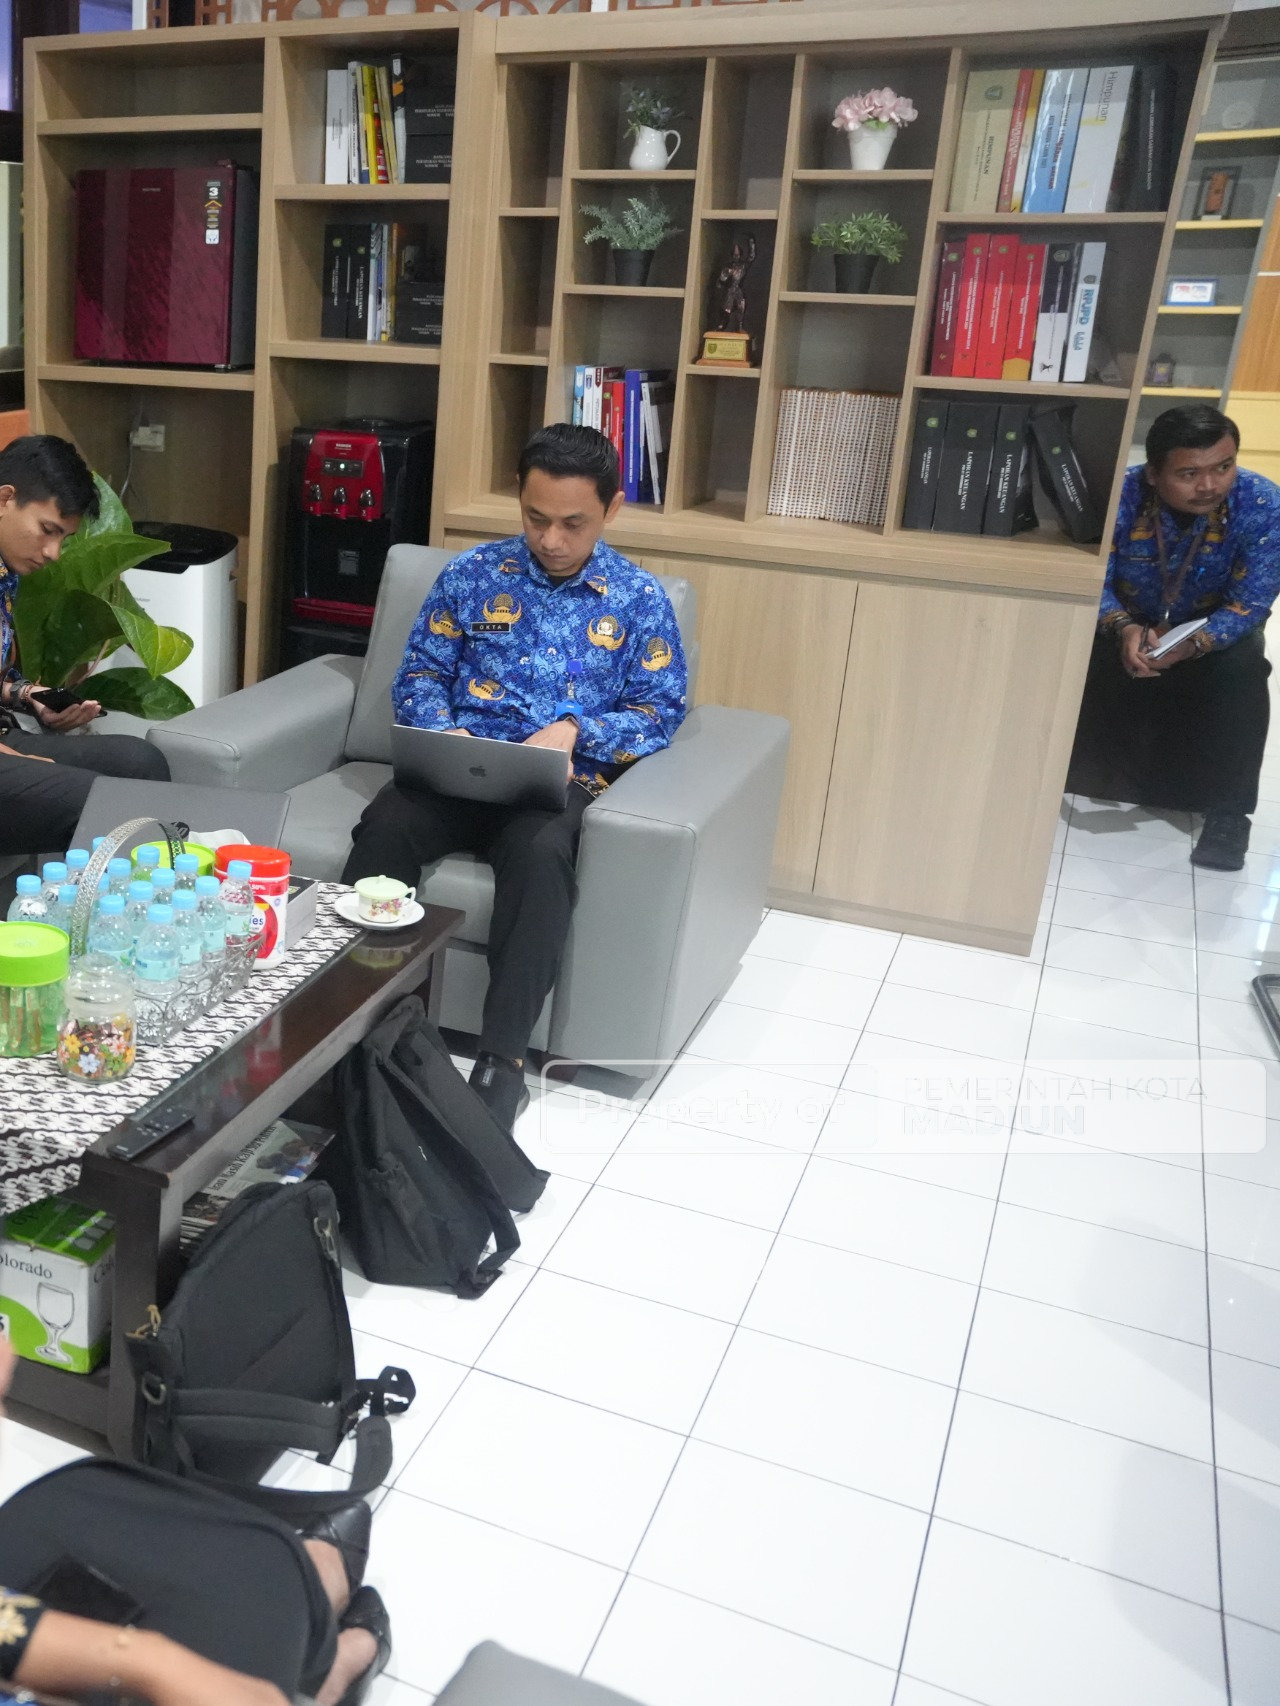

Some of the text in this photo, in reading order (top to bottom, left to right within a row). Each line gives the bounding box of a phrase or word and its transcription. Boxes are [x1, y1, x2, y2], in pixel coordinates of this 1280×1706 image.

[208, 186, 219, 197] 3
[1079, 288, 1095, 325] RPJPD
[964, 451, 974, 478] LAPORAN
[1003, 454, 1013, 481] LAPORAN
[1061, 463, 1074, 486] LAPORAN
[960, 478, 970, 510] KEUANGAN
[999, 482, 1009, 513] KEUANGAN
